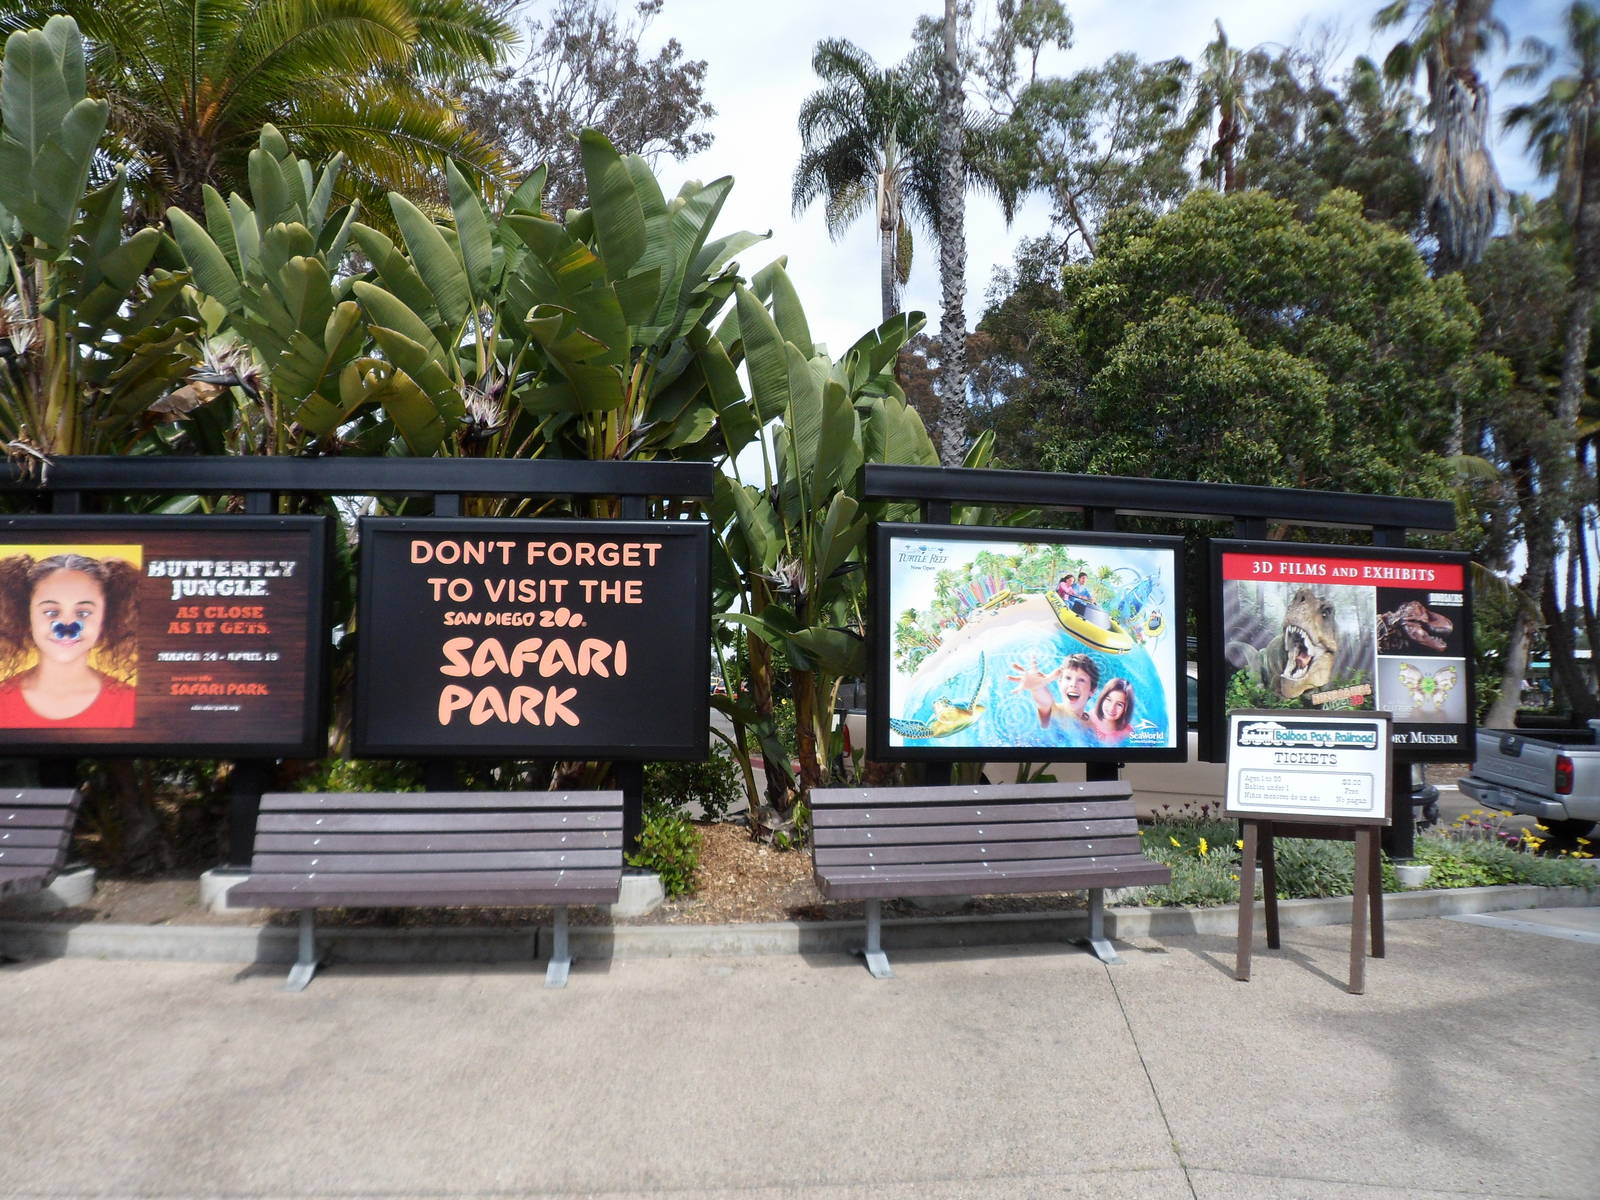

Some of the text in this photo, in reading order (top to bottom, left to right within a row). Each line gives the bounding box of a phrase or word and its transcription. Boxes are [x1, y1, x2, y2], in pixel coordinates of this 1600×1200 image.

[410, 540, 662, 567] DON'T FORGET
[147, 560, 297, 577] BUTTERFLY
[1252, 561, 1436, 581] 3D FILMS AND EXHIBITS
[427, 578, 643, 604] TO VISIT THE
[176, 606, 265, 619] AS CLOSE
[443, 611, 482, 626] SAN
[484, 612, 535, 626] DIEGO
[168, 621, 191, 634] AS
[196, 621, 215, 634] IT
[227, 652, 262, 662] APRIL
[440, 637, 627, 678] SAFARI
[170, 683, 270, 696] SAFARI PARK
[438, 684, 580, 726] PARK
[1129, 731, 1164, 740] SeaWorld
[1275, 730, 1374, 743] Balboa Park Railroad
[1409, 731, 1459, 744] MUSEUM
[1274, 751, 1338, 765] TICKETS
